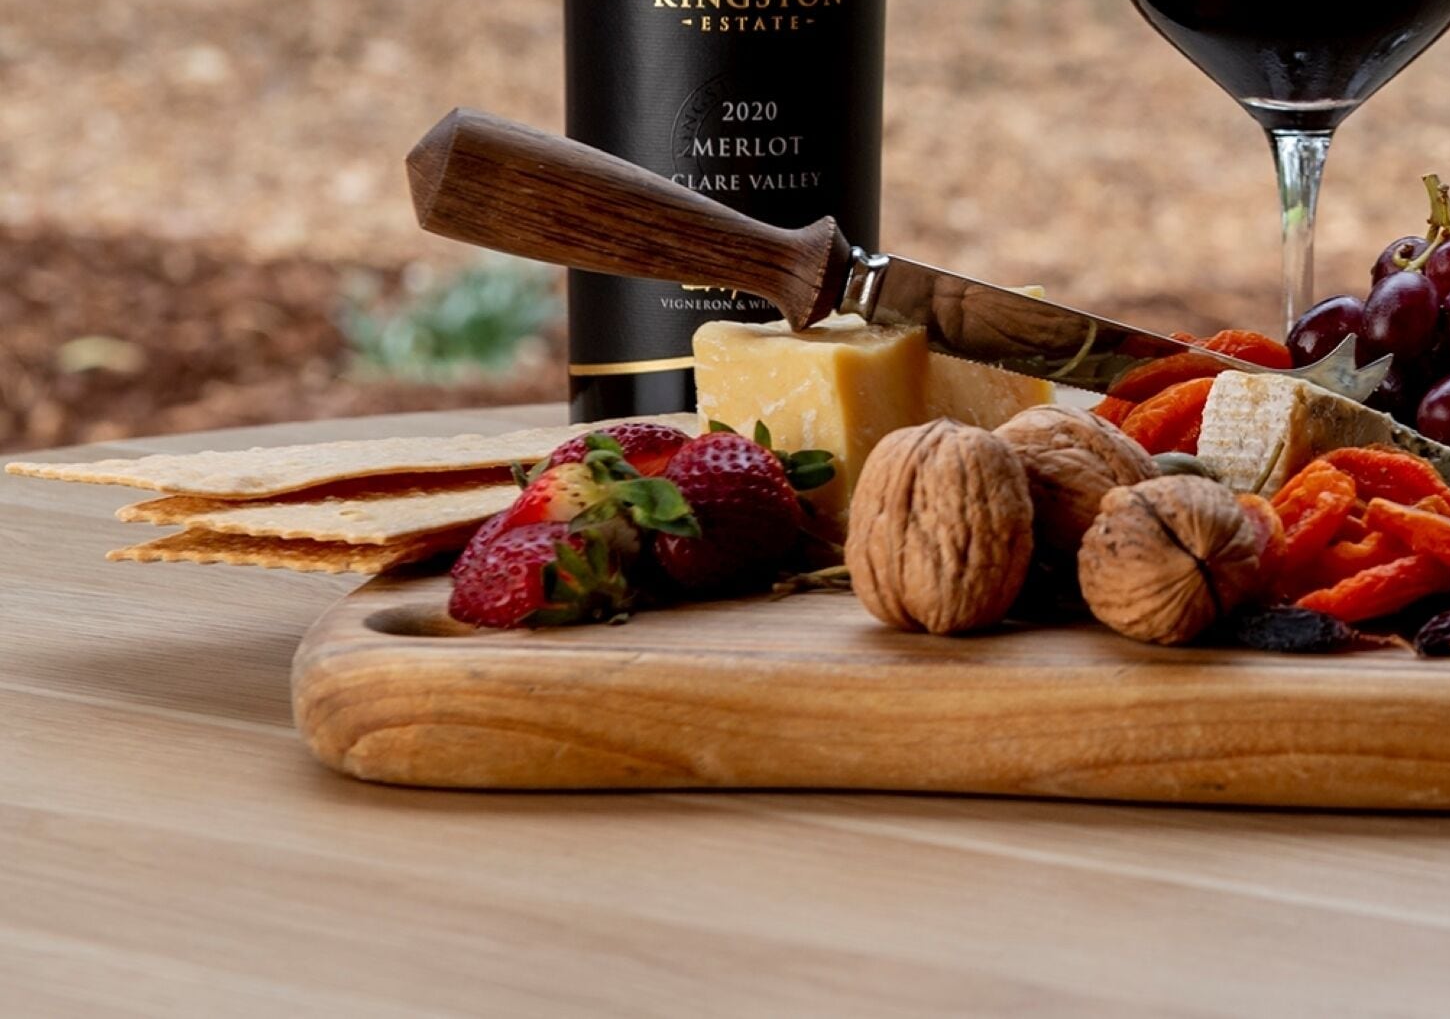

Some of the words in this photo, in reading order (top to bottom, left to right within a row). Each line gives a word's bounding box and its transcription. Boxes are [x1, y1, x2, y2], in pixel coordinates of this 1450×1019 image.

[701, 15, 799, 31] ESTATE
[722, 101, 778, 121] 2020
[691, 136, 804, 157] MERLOT
[671, 173, 741, 191] CLARE
[749, 171, 822, 191] VALLEY
[660, 297, 733, 311] VIGNERON
[736, 299, 746, 311] &
